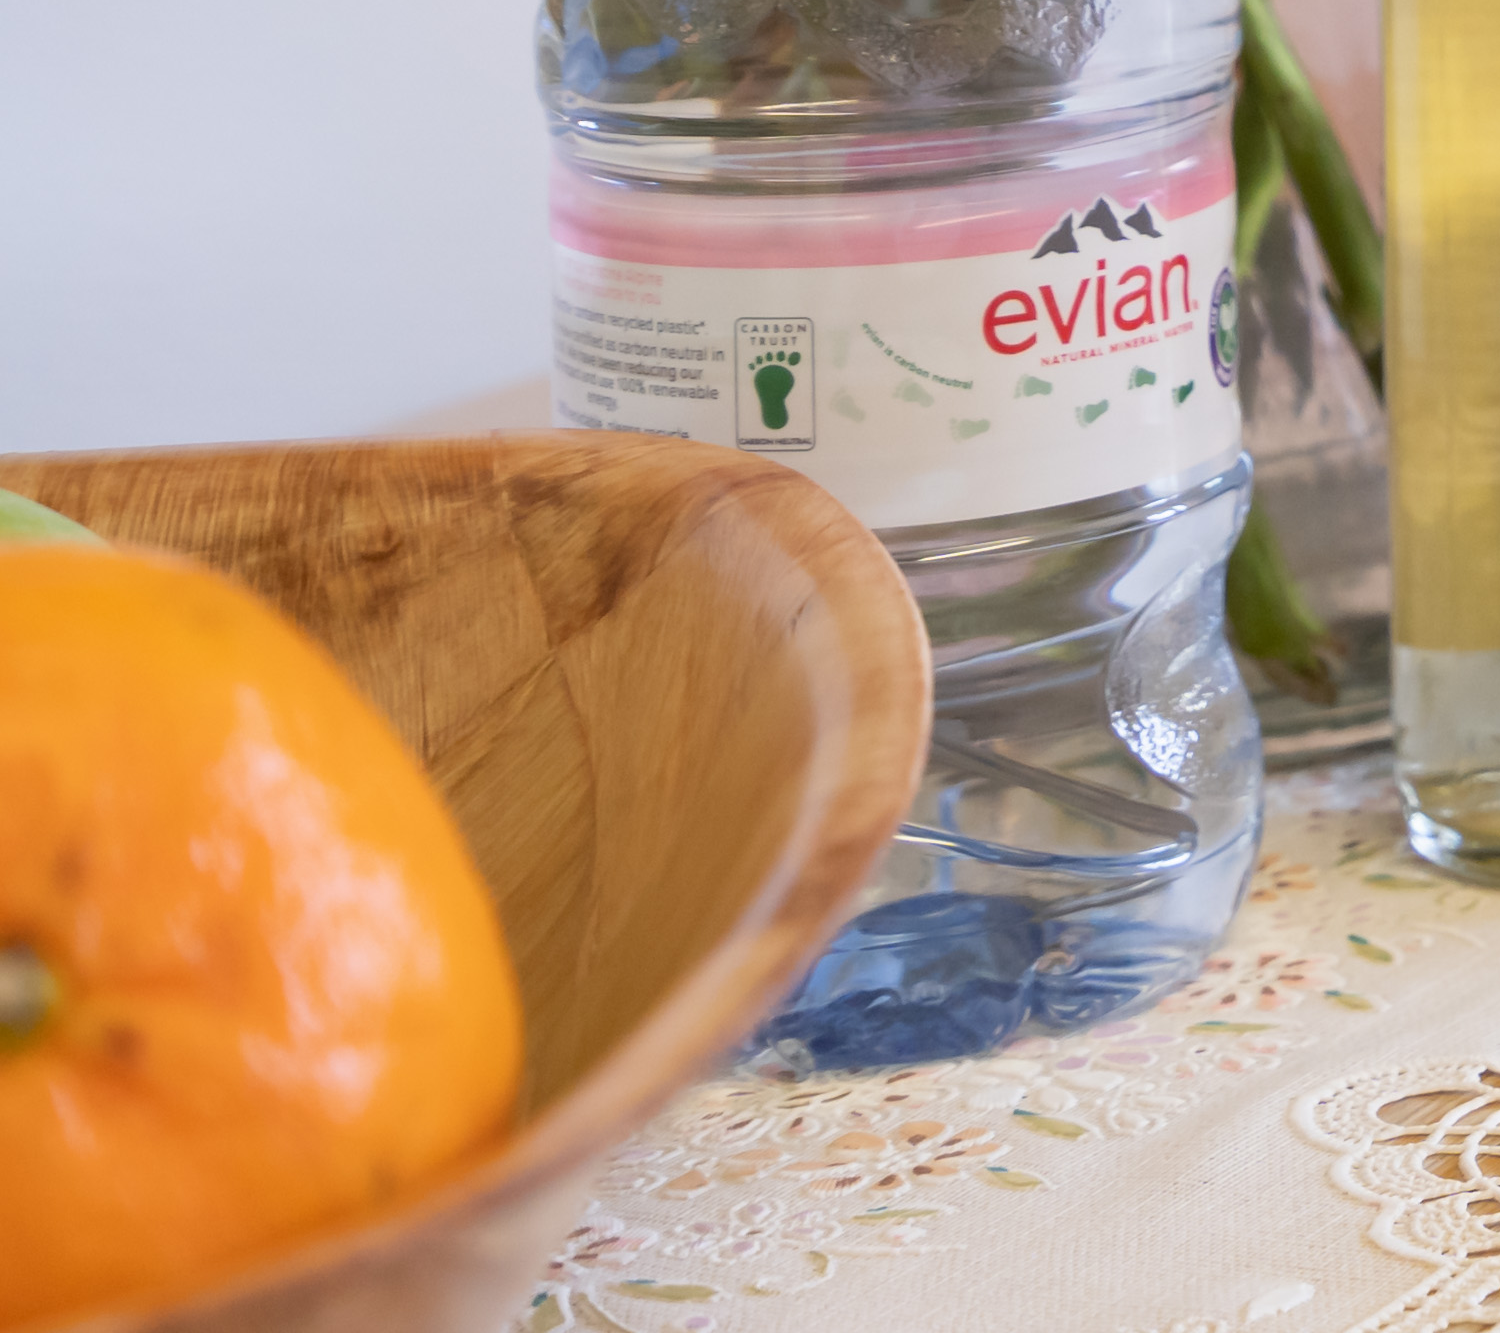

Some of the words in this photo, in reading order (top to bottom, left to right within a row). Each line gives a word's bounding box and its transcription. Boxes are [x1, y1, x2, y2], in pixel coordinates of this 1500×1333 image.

[982, 253, 1189, 355] evian
[740, 323, 807, 334] CARBON
[749, 335, 798, 346] TRUST
[660, 345, 708, 362] neutral
[1040, 347, 1103, 367] NATURAL
[648, 383, 720, 400] renewable
